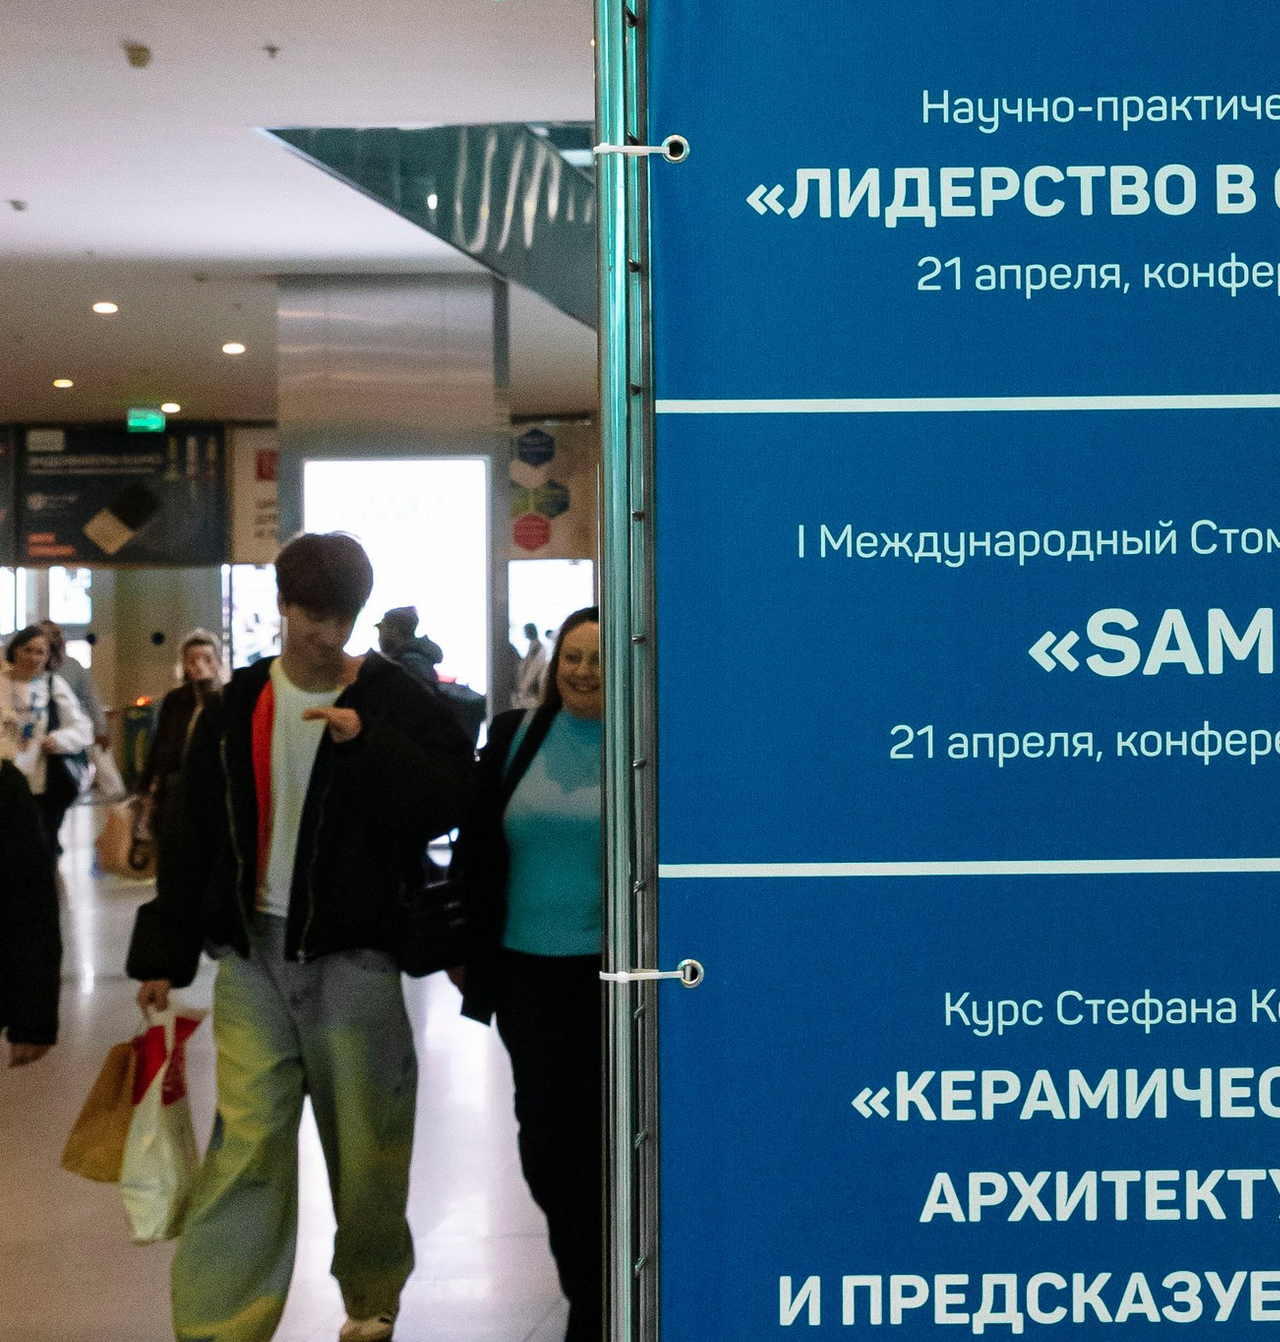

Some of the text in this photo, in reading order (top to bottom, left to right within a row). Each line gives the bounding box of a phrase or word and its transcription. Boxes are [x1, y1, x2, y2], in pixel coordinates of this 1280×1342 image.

[747, 165, 1198, 229] «ЛИДЕРСТВО
[1217, 165, 1258, 215] В
[918, 257, 962, 292] 21
[976, 264, 1131, 301] апреля,
[821, 521, 1178, 569] Международный
[1029, 608, 1275, 678] «SAM
[891, 725, 934, 760] 21
[948, 733, 1104, 769] апреля,
[946, 993, 1044, 1036] Курс
[1058, 990, 1238, 1035] Стефана
[780, 1276, 822, 1327] И
